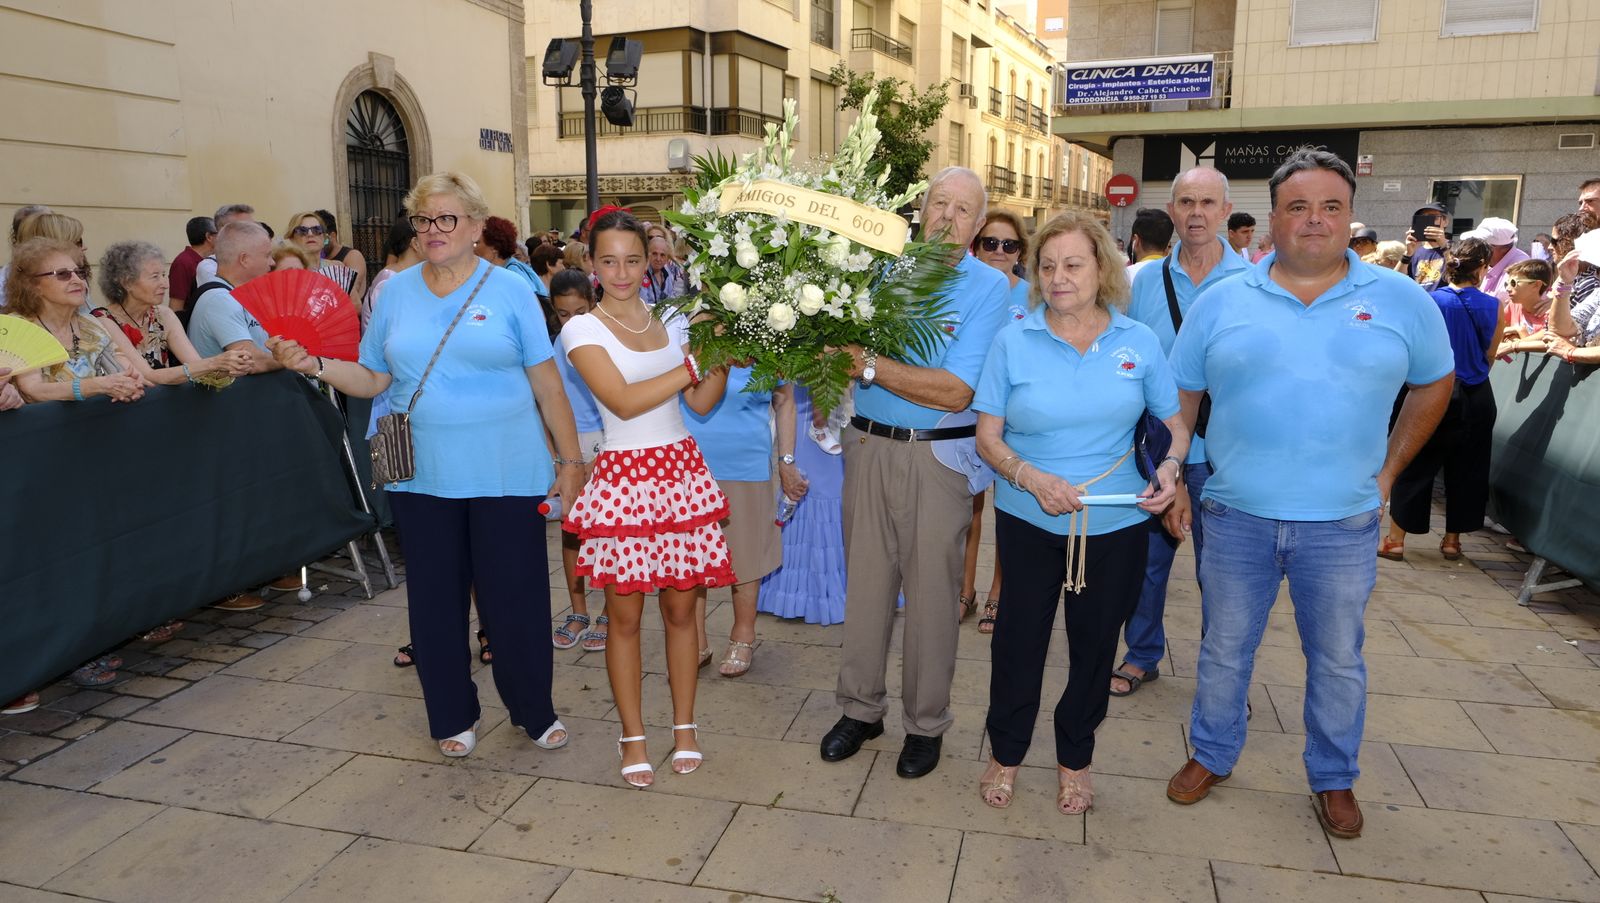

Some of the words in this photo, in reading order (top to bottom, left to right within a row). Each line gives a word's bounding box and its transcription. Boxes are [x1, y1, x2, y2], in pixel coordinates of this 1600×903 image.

[1071, 67, 1136, 80] CLINICA
[1141, 63, 1208, 77] DENTAL
[1102, 80, 1142, 88] Implantes
[1183, 76, 1211, 84] Dental
[1161, 85, 1201, 93] Calvache
[1069, 96, 1119, 104] ORTODONCIA
[1225, 144, 1269, 156] MAÑAS
[734, 189, 797, 208] AMIGOS
[807, 200, 840, 220] DEL
[852, 214, 884, 236] 600
